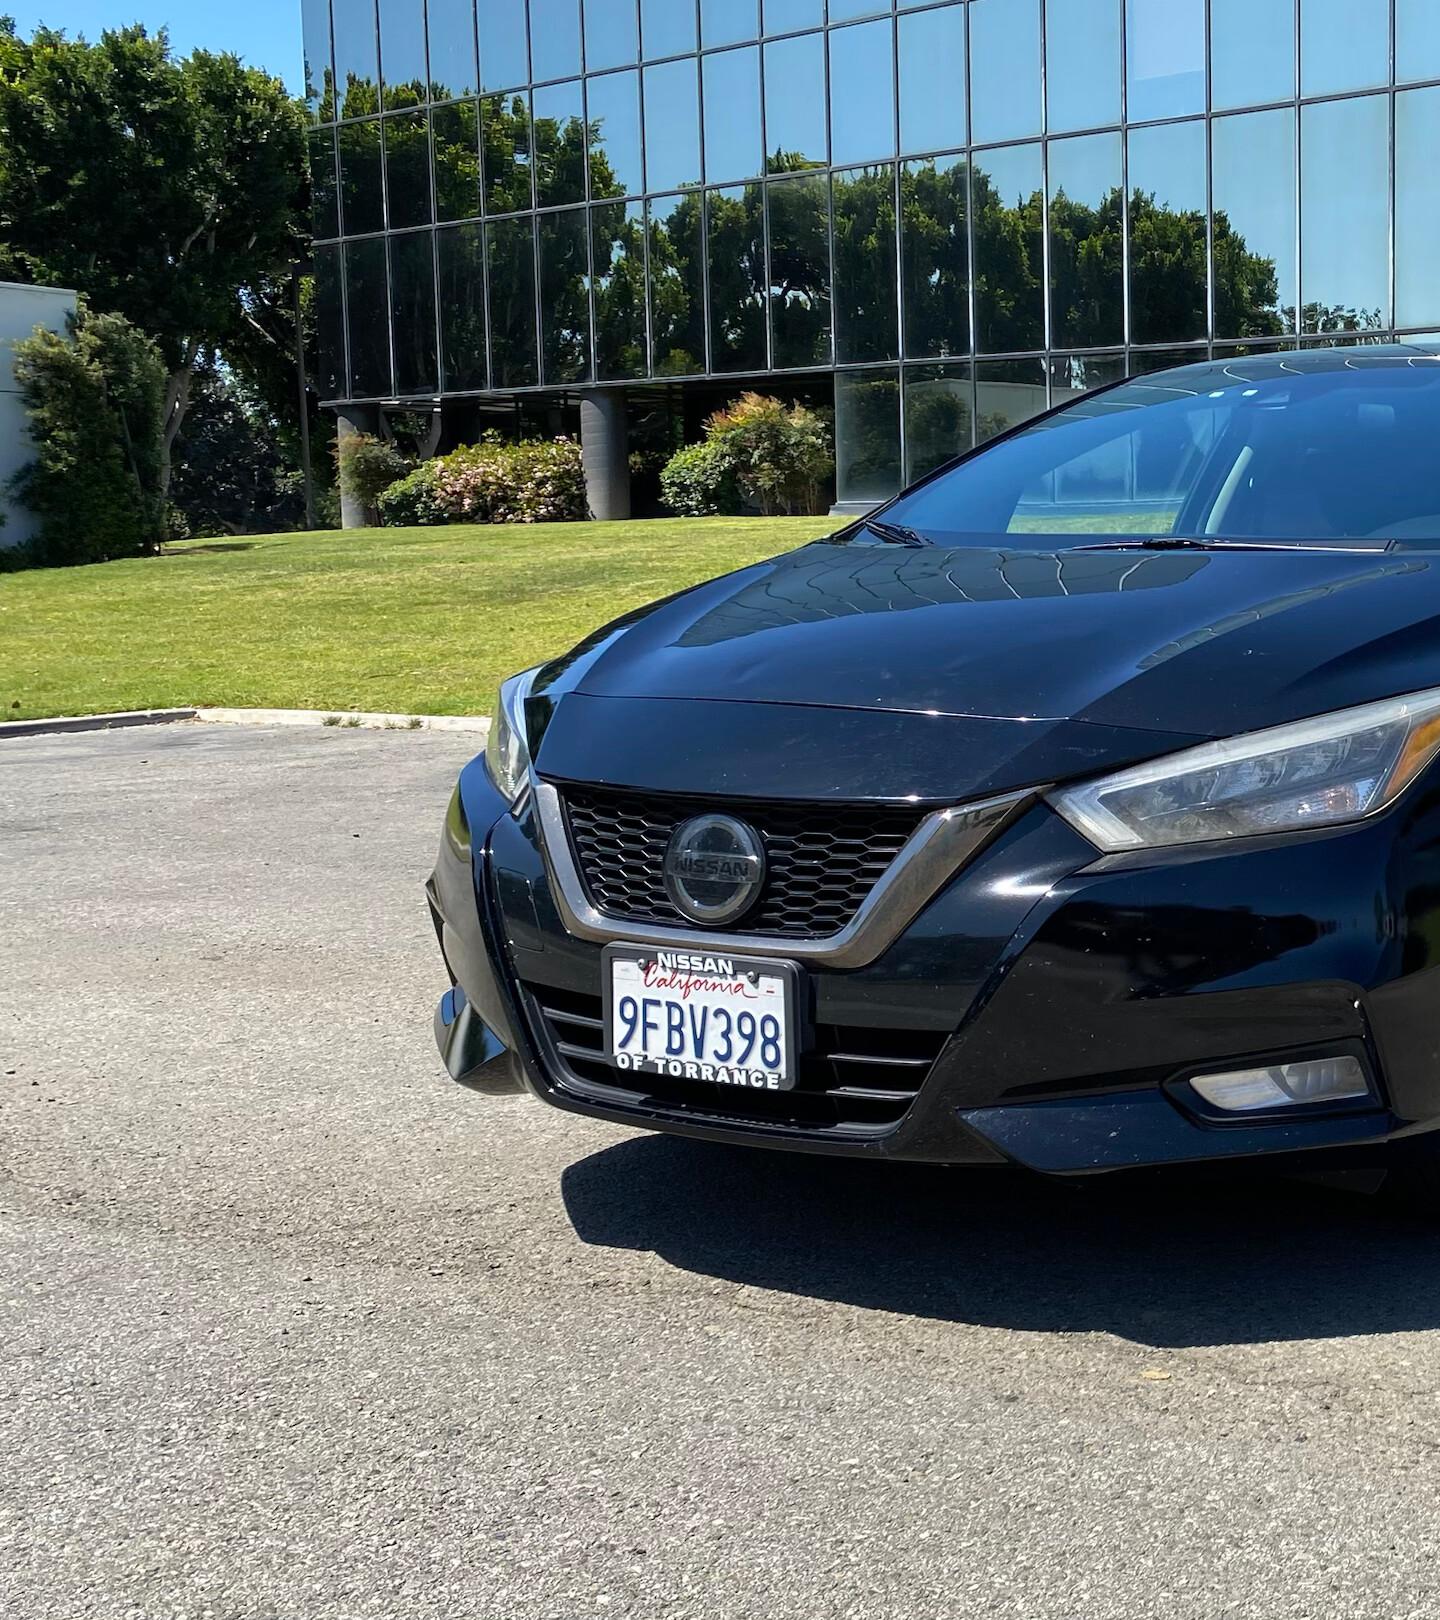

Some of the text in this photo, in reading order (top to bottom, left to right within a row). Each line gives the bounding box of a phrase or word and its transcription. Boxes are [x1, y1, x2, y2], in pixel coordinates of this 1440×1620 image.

[674, 857, 748, 876] NISSAN
[643, 961, 758, 1000] California
[657, 952, 733, 975] NISSAN
[618, 996, 781, 1069] 9FBV398
[616, 1052, 780, 1089] OF TORRANCE
